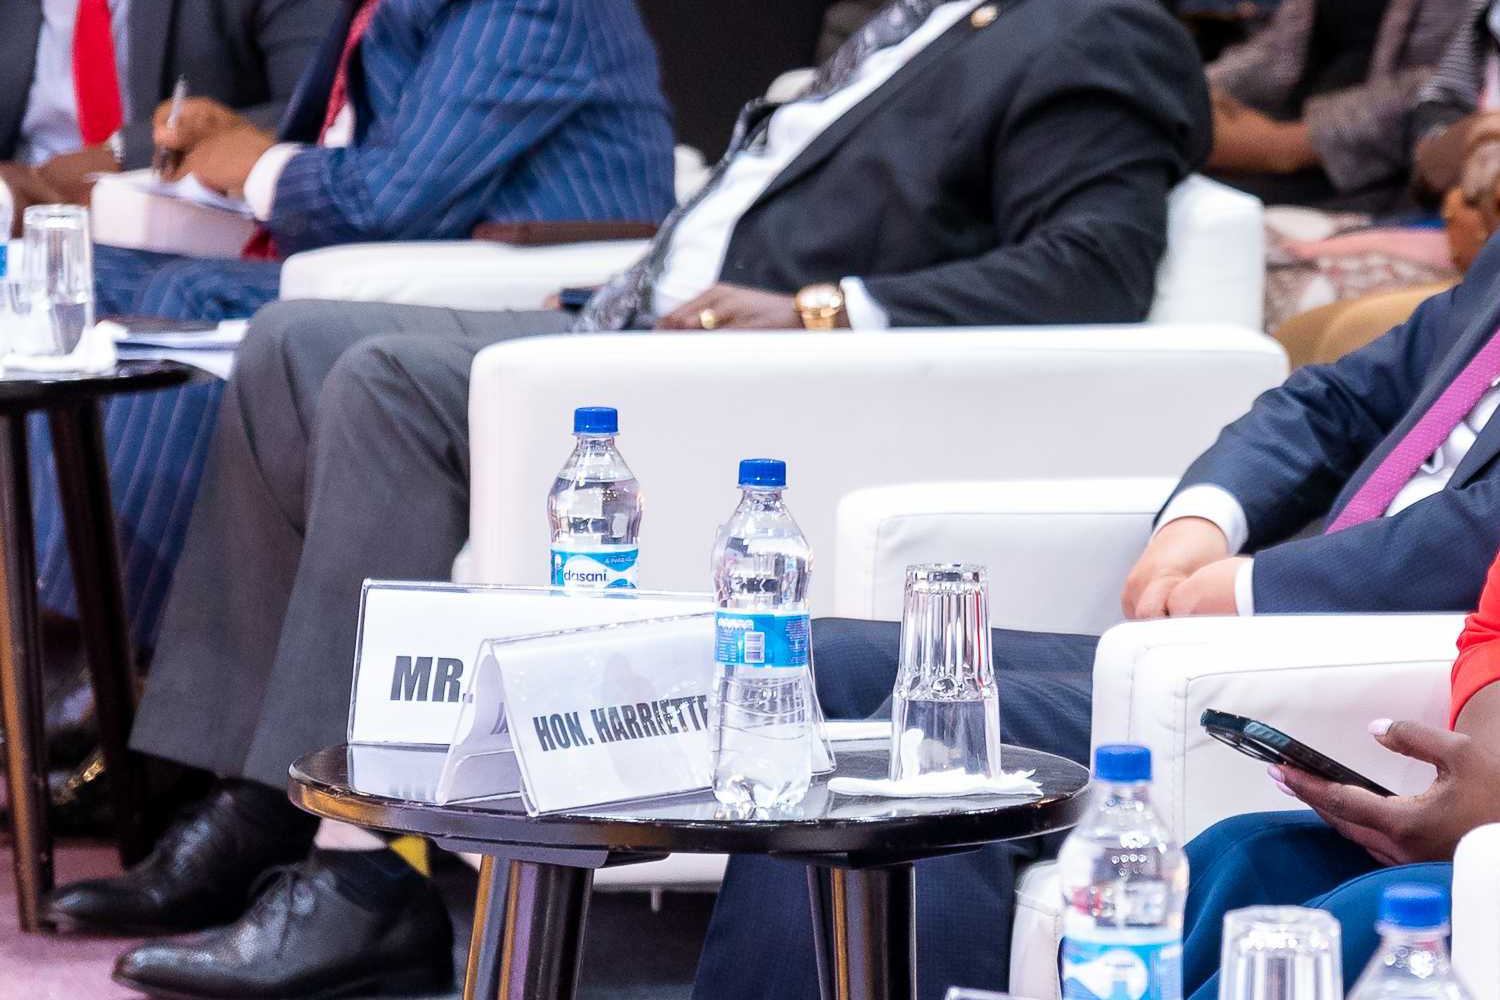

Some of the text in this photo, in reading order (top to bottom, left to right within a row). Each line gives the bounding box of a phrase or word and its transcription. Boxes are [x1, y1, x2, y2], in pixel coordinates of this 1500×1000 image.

[564, 569, 607, 582] dasani
[390, 656, 473, 703] MR.
[533, 712, 594, 752] HON.
